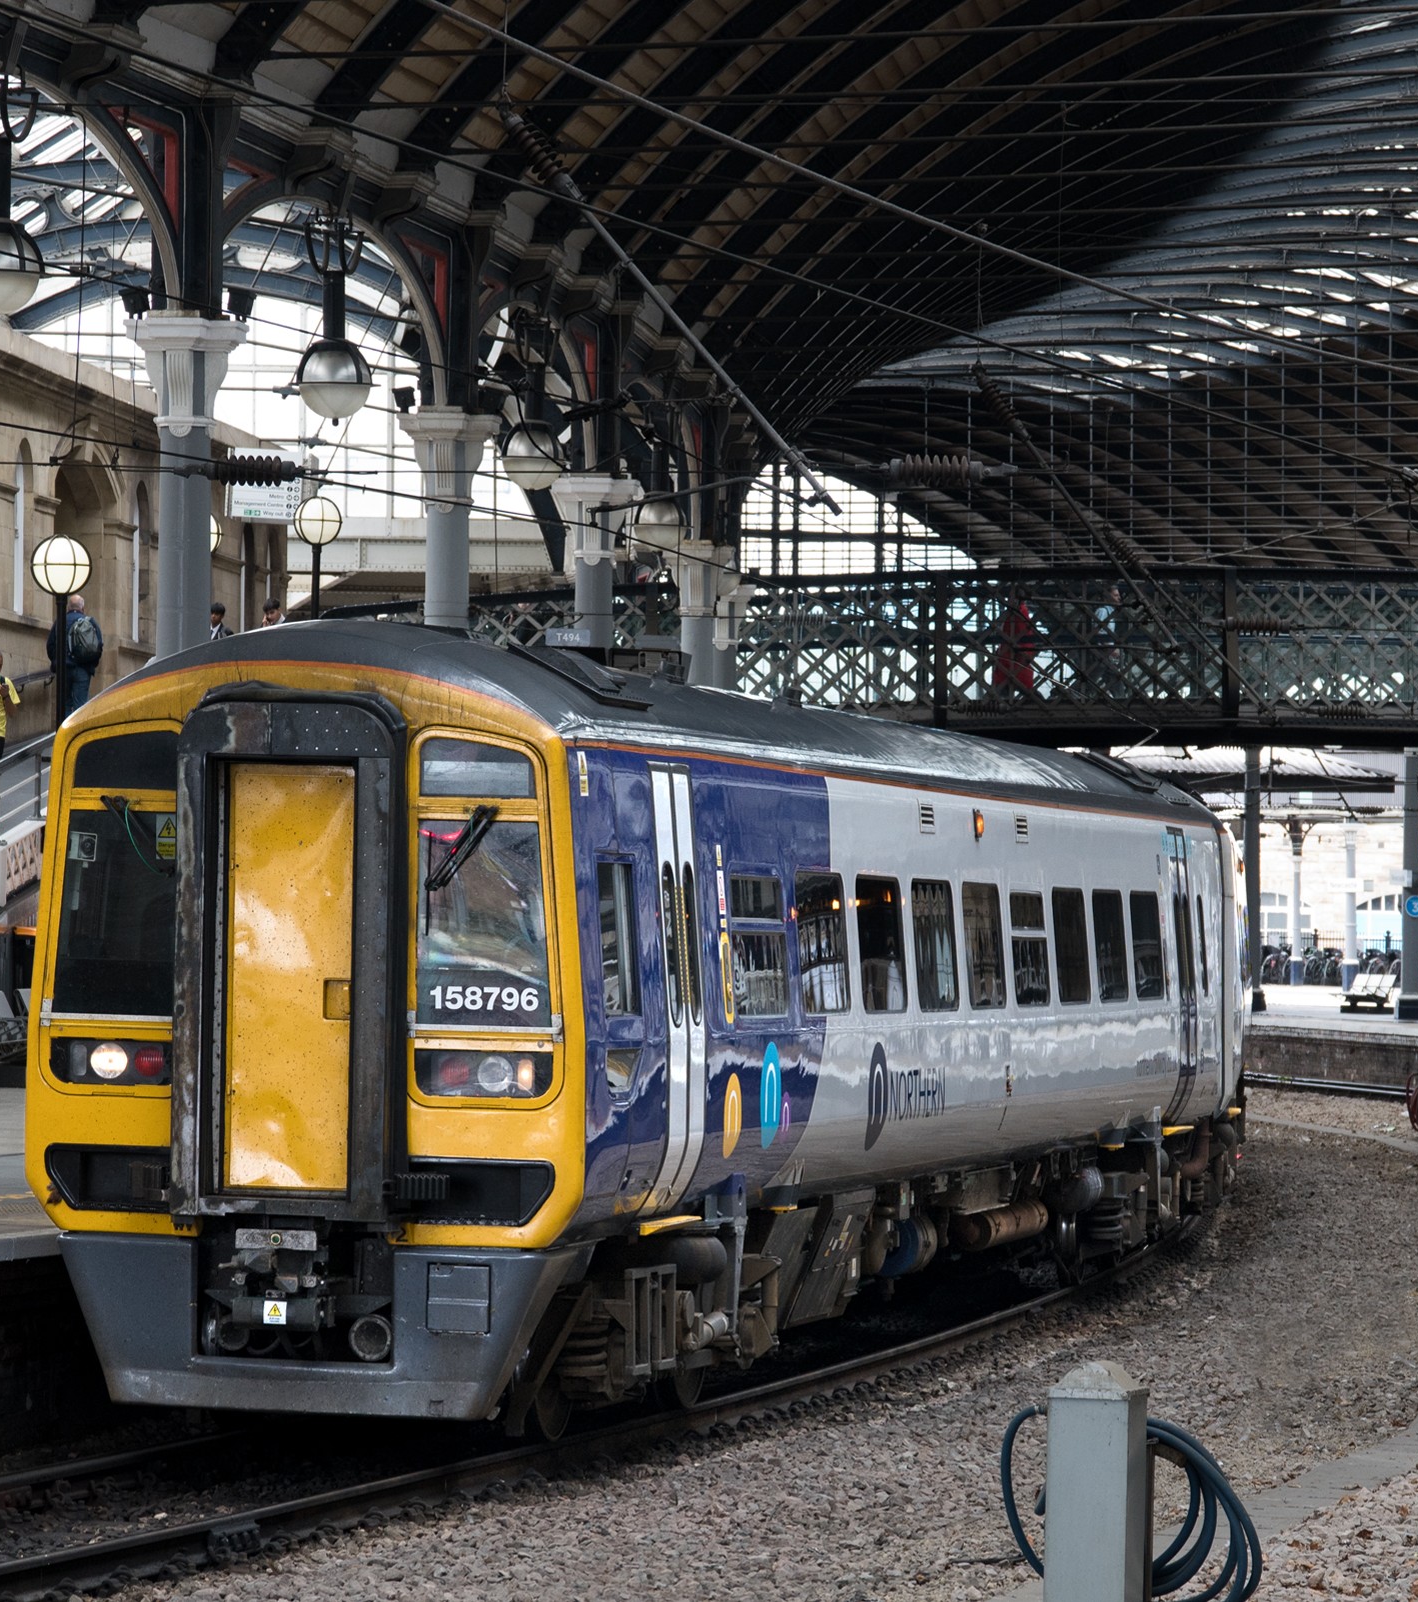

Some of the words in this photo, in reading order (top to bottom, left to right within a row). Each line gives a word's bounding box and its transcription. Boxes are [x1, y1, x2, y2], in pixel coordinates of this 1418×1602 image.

[234, 500, 267, 508] Management
[556, 633, 580, 642] T494
[1412, 902, 1418, 912] 3
[430, 985, 539, 1011] 158796
[888, 1067, 946, 1122] NORTHERN
[396, 1227, 408, 1243] 2
